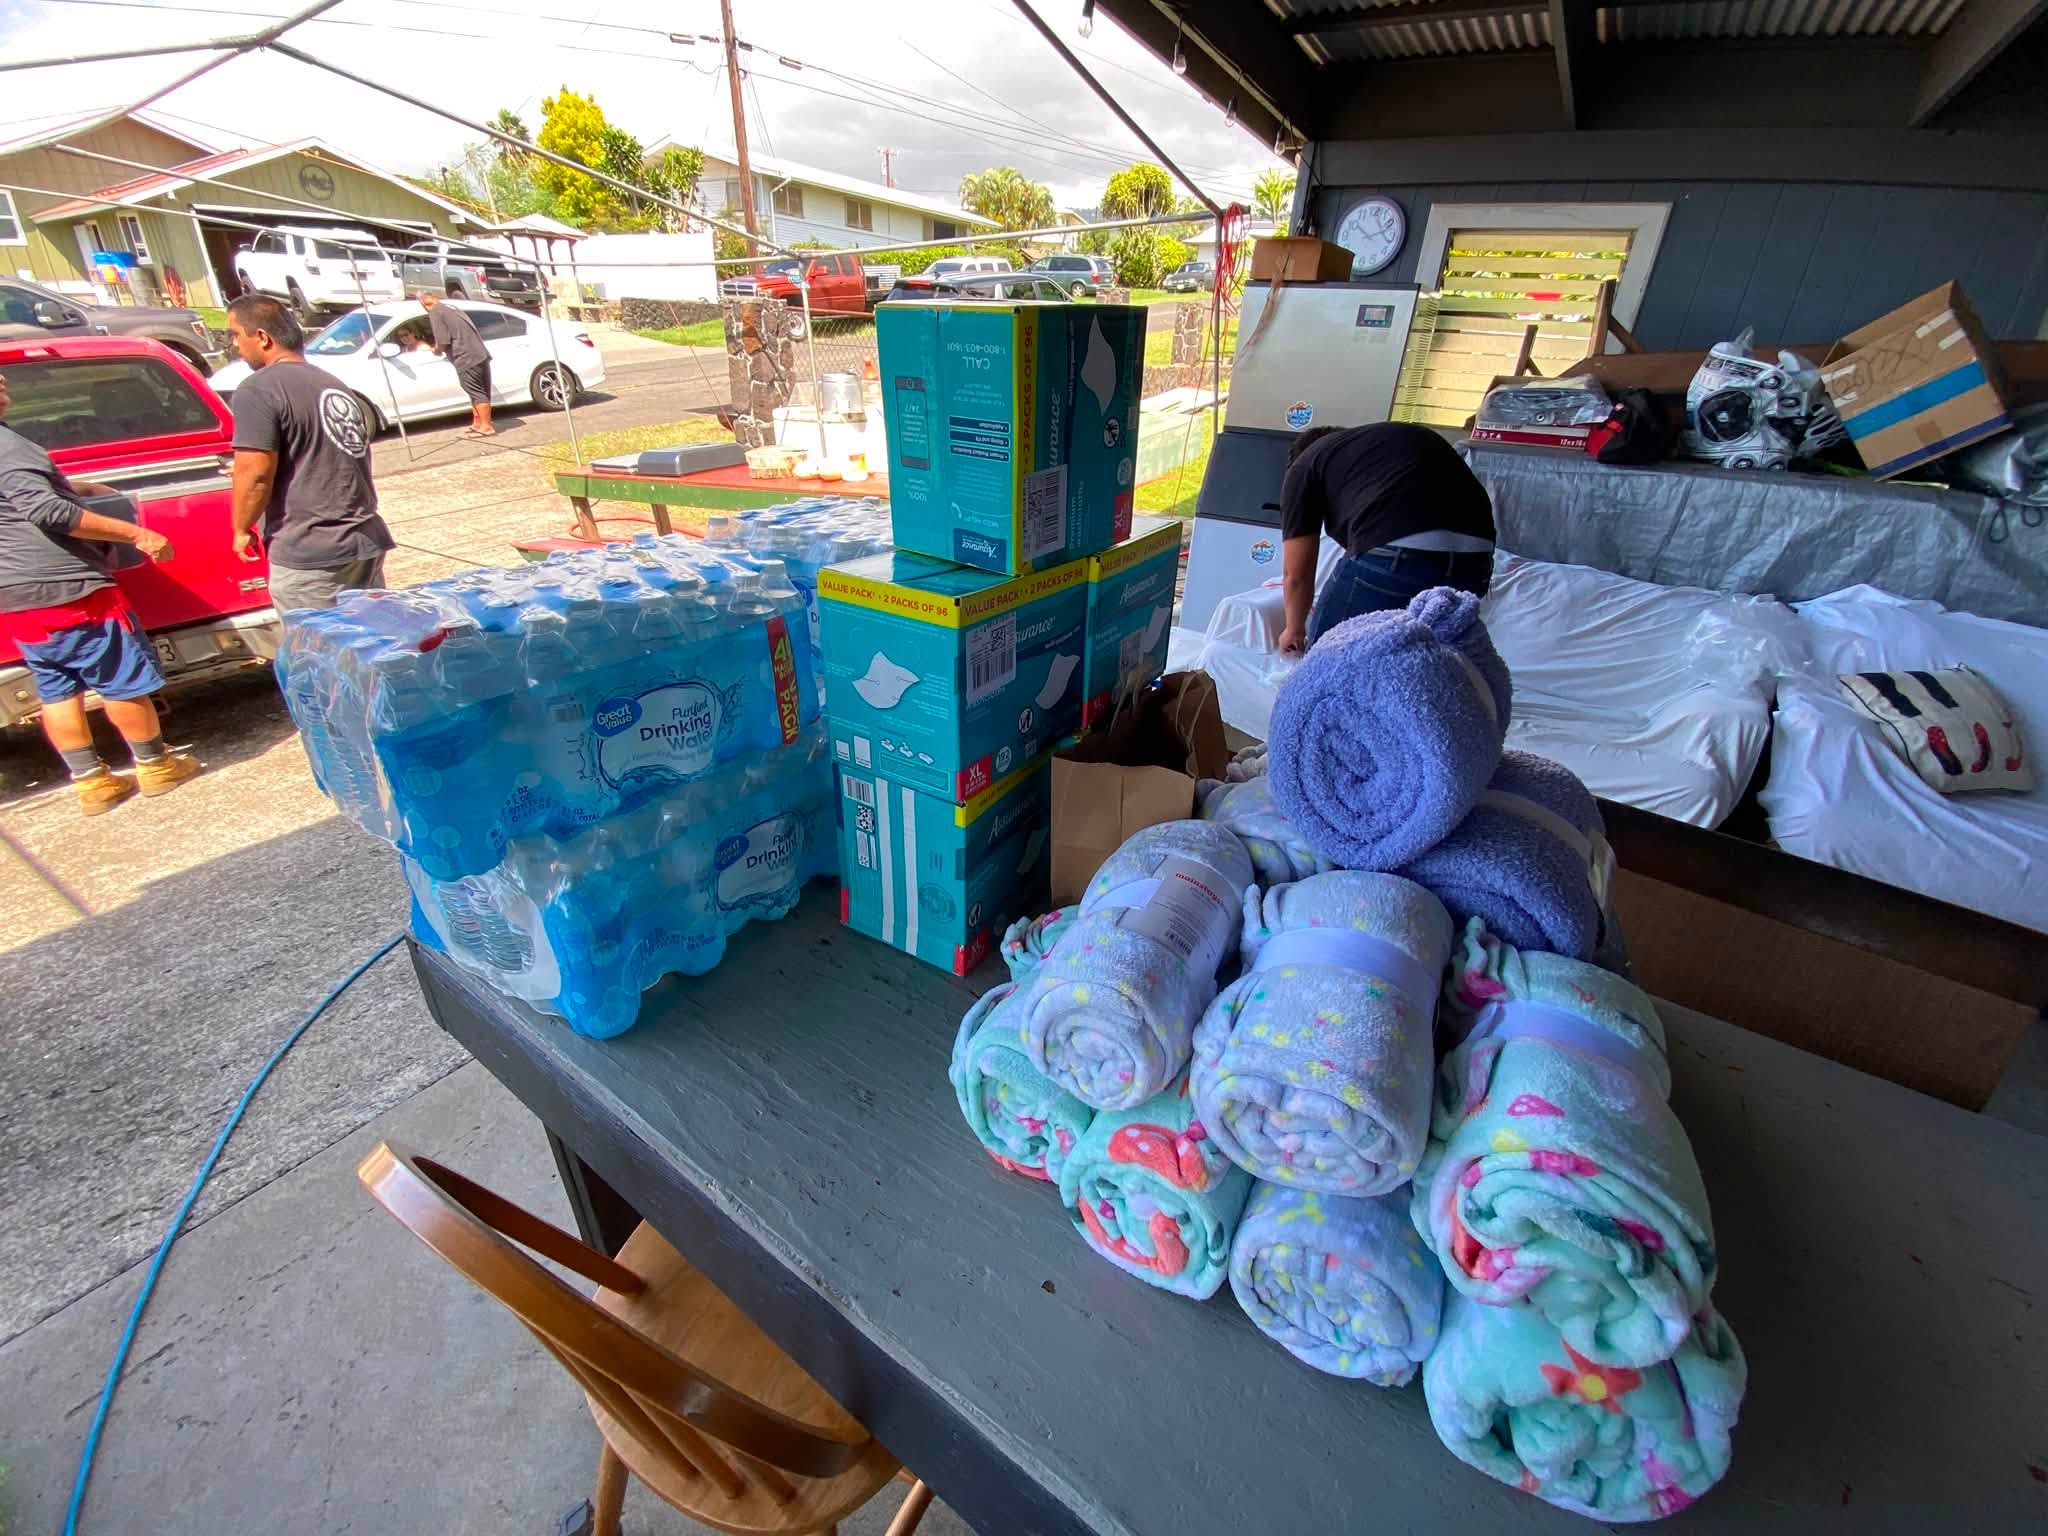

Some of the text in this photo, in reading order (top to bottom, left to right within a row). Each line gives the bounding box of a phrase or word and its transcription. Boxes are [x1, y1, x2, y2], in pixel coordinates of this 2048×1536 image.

[1348, 220, 1360, 231] 10
[1024, 325, 1032, 346] 96
[947, 343, 1006, 355] 1-800-403-1601
[962, 356, 990, 370] CALL
[1024, 353, 1032, 378] OF
[1023, 384, 1031, 439] PACKS
[1049, 390, 1060, 466] urance
[1114, 509, 1124, 529] XL
[961, 541, 997, 558] Assurance
[822, 580, 849, 594] VALUE
[883, 595, 889, 604] 2
[891, 596, 920, 610] PACKS
[922, 604, 935, 613] OF
[936, 607, 948, 617] 96
[965, 598, 995, 617] VALUE
[1030, 584, 1035, 594] 2
[1036, 575, 1061, 592] PACKS
[1061, 571, 1073, 582] OF
[596, 703, 632, 725] Great
[672, 695, 709, 721] Purified
[605, 714, 633, 730] Value
[640, 712, 712, 742] Drinking
[969, 762, 983, 778] XL
[746, 838, 795, 869] Drinkin
